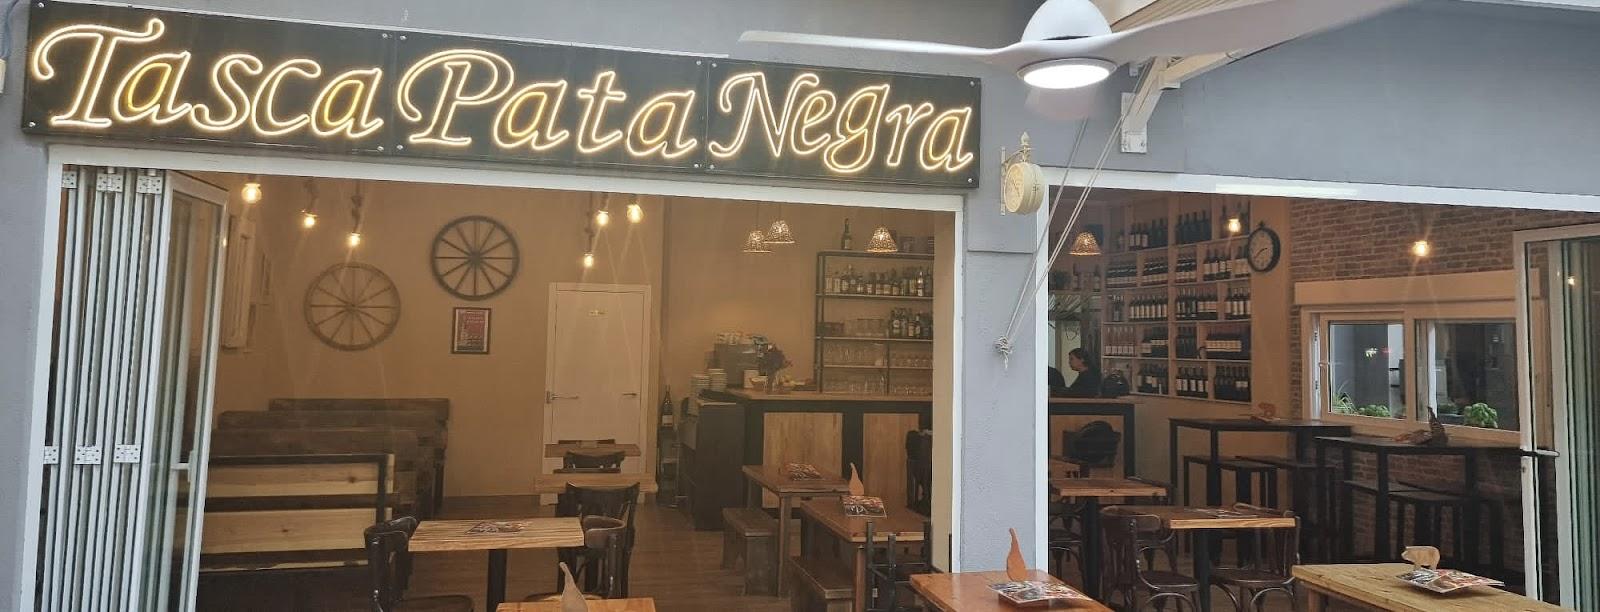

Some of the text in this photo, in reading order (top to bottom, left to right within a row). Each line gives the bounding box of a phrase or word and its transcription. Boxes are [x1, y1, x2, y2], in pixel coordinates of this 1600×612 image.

[32, 17, 975, 174] Tasca Pata Negra
